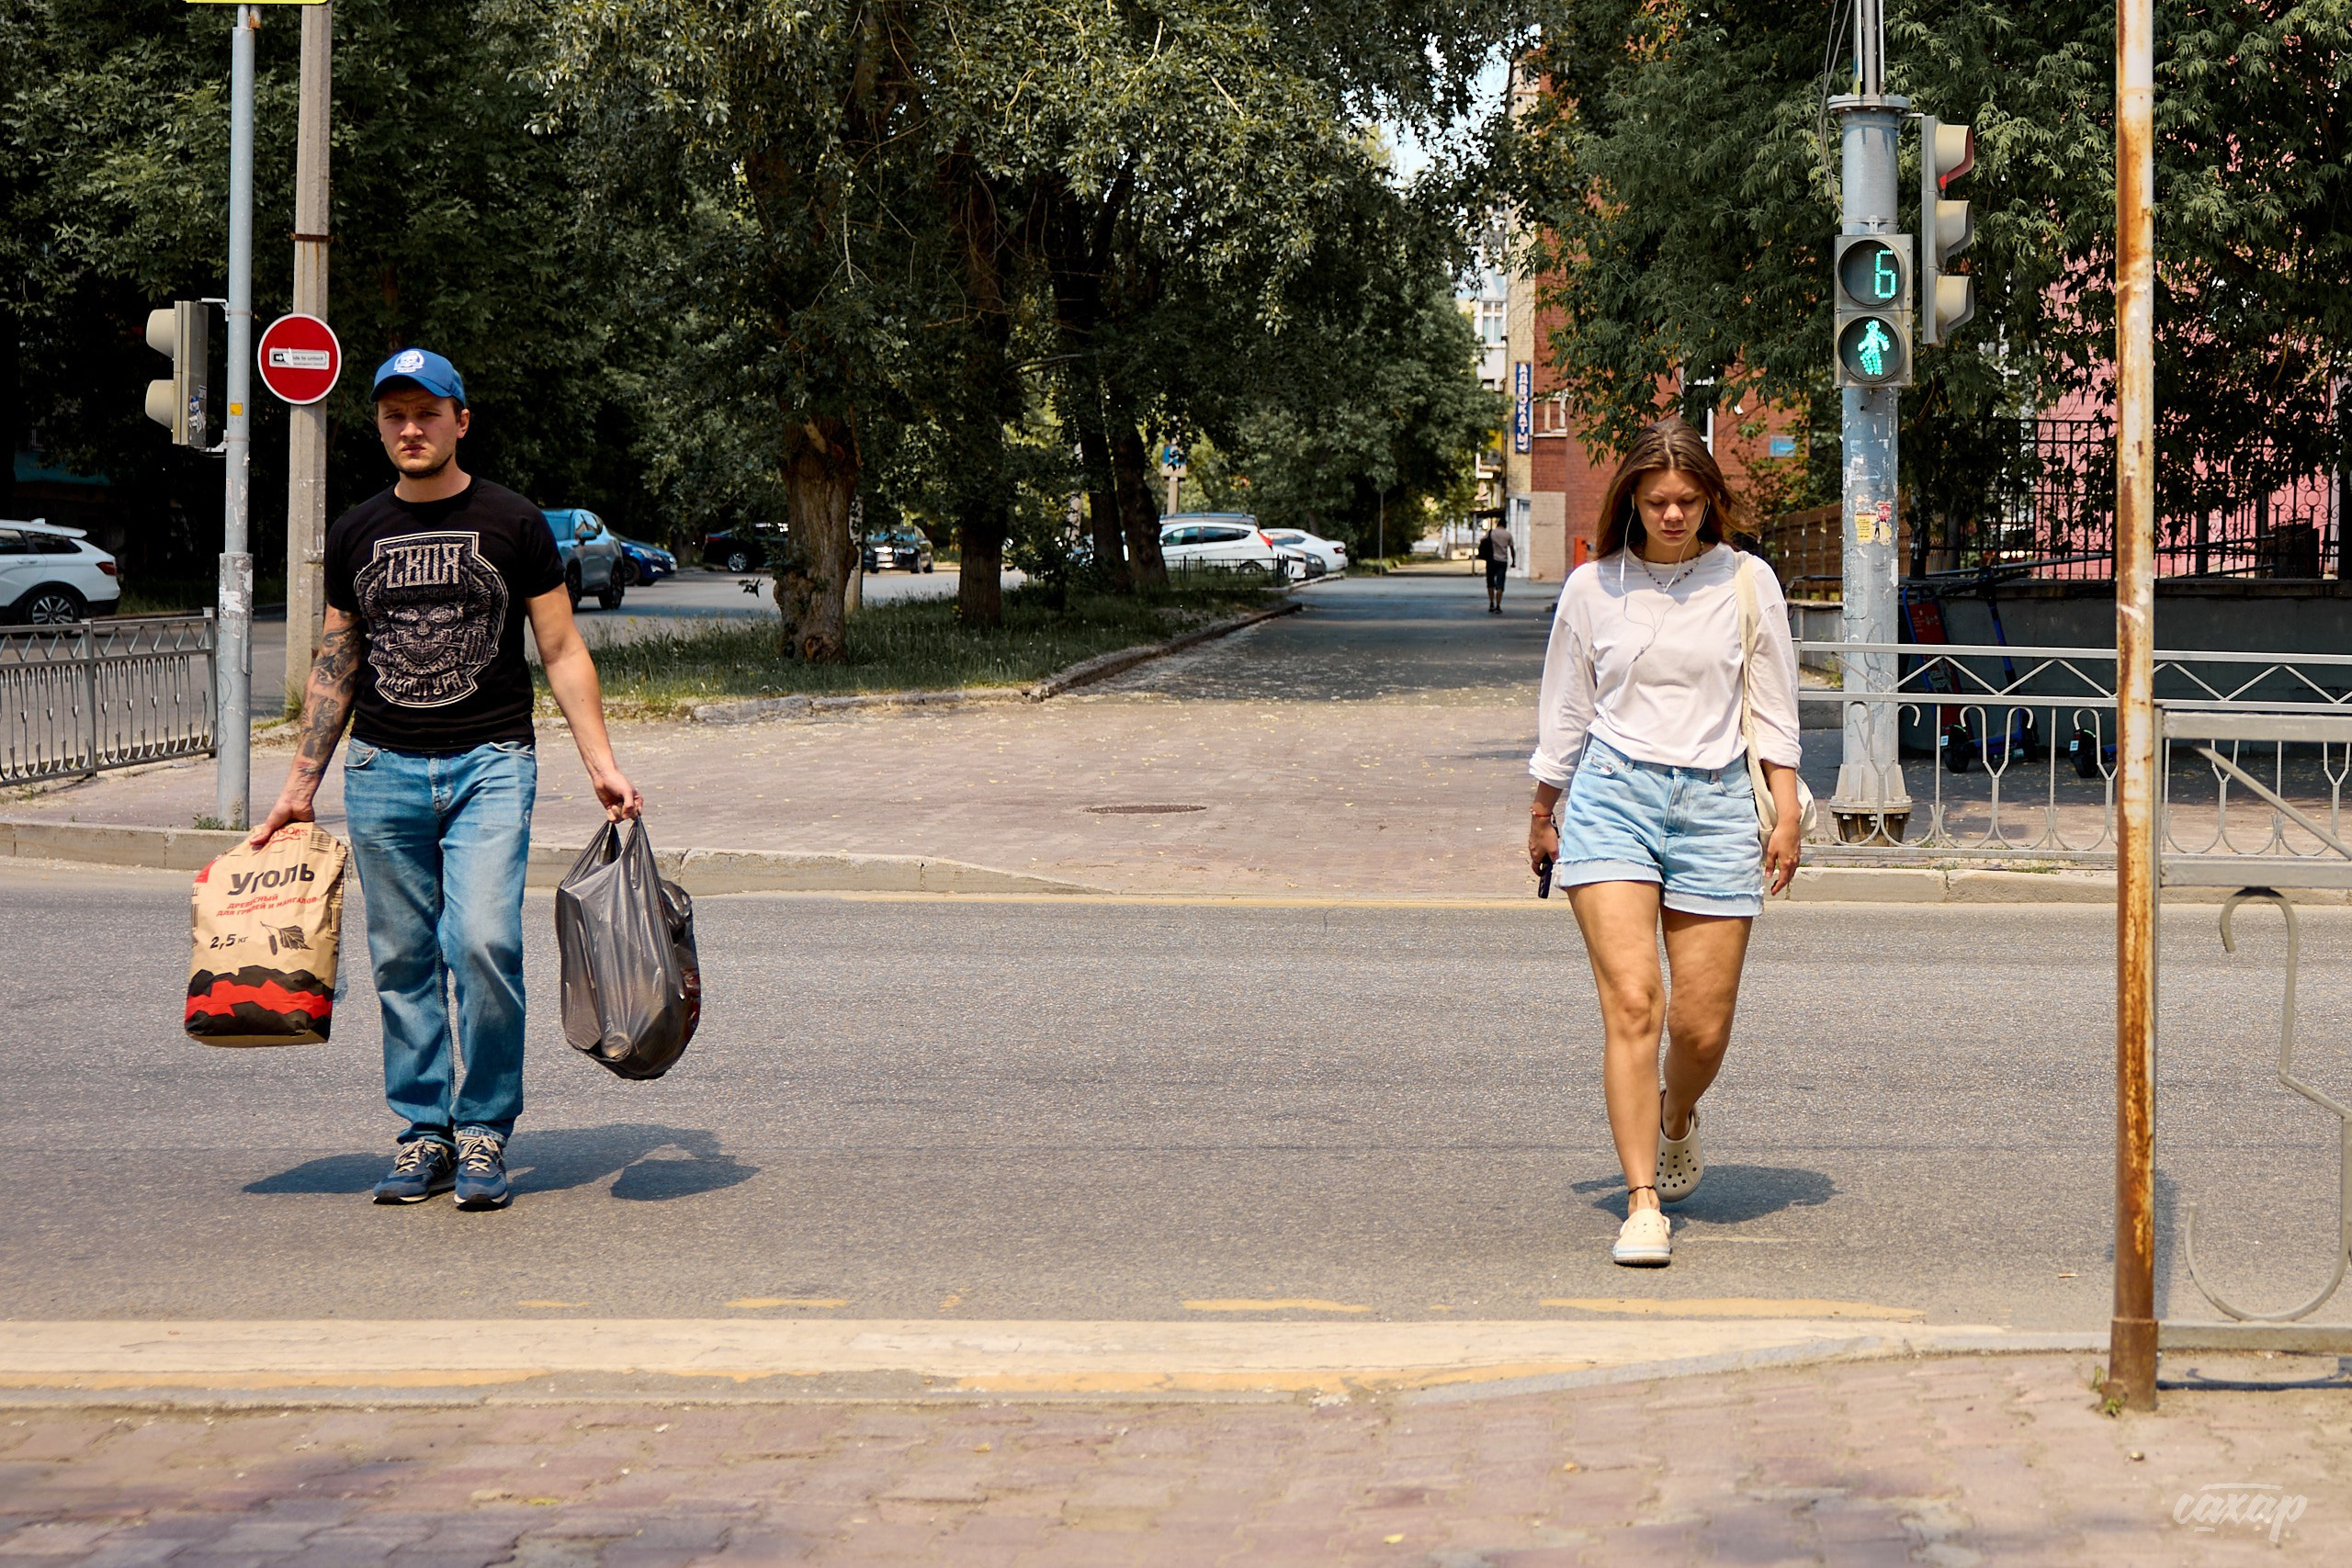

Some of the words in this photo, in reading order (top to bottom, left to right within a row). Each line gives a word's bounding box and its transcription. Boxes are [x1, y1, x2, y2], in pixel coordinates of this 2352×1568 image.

[1875, 249, 1896, 299] 6
[1517, 363, 1529, 444] АДВОКАТЫ
[386, 543, 464, 589] СВОЯ
[227, 894, 279, 909] ДРЕВЕСНЫЙ
[209, 933, 237, 950] 2,5
